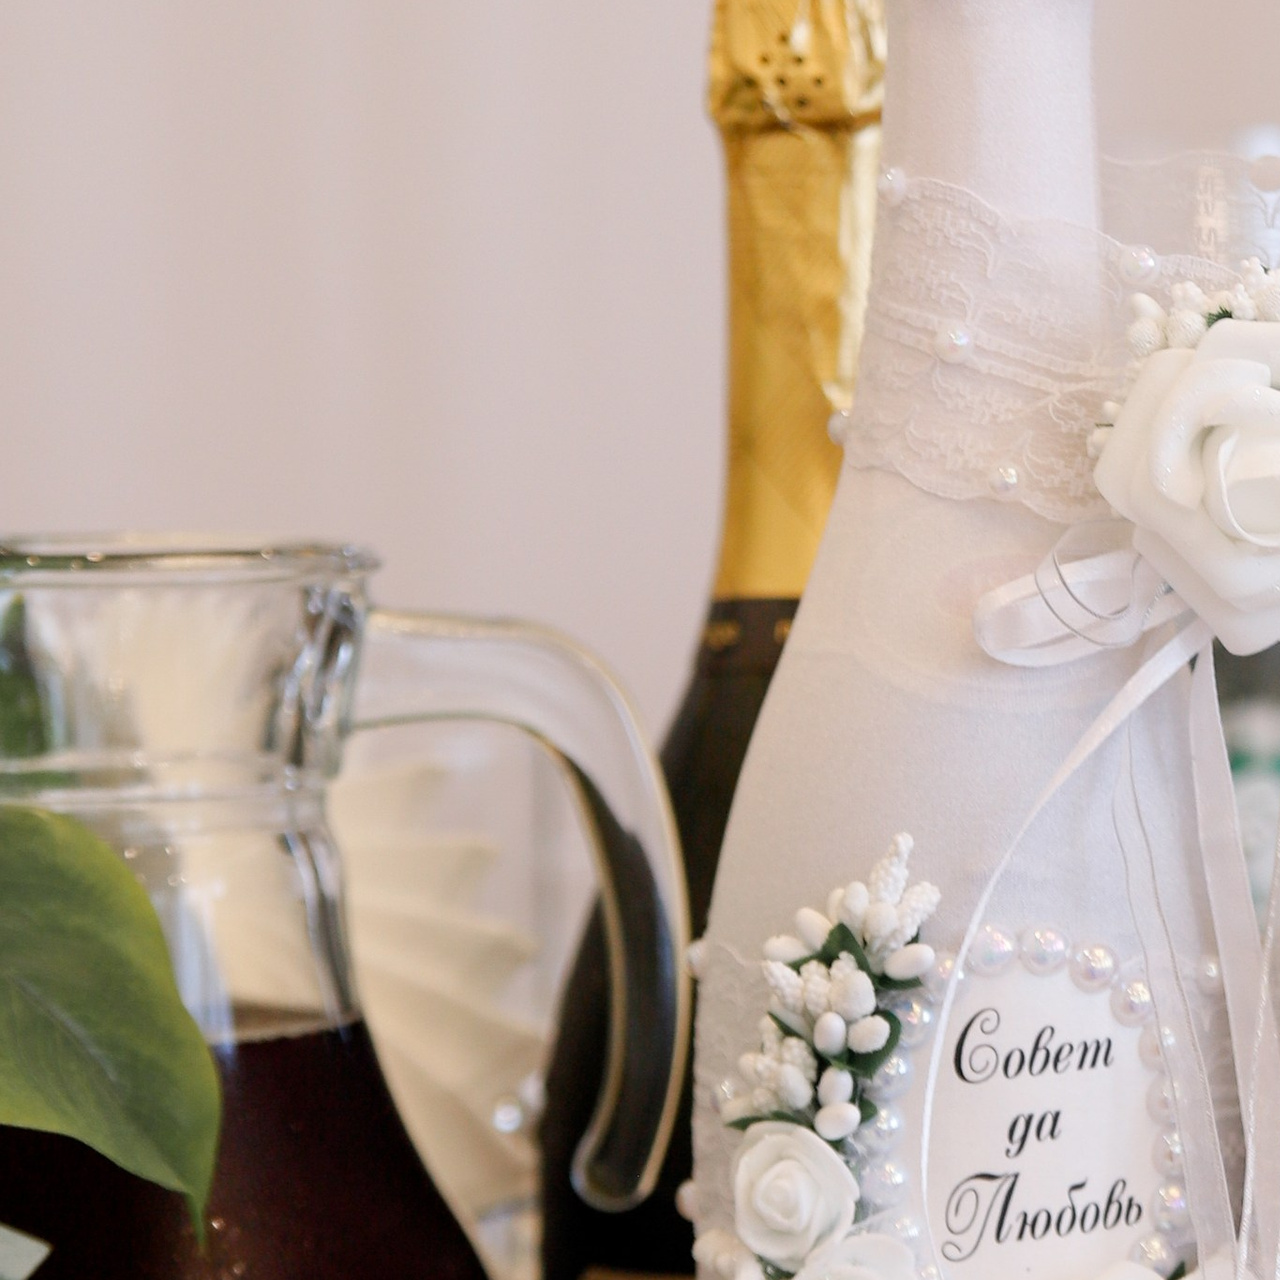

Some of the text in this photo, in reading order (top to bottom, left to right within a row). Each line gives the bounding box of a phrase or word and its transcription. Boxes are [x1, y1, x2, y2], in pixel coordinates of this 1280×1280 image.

[953, 1007, 1115, 1085] Совет
[1004, 1109, 1062, 1159] да
[941, 1171, 1144, 1263] Любовь
